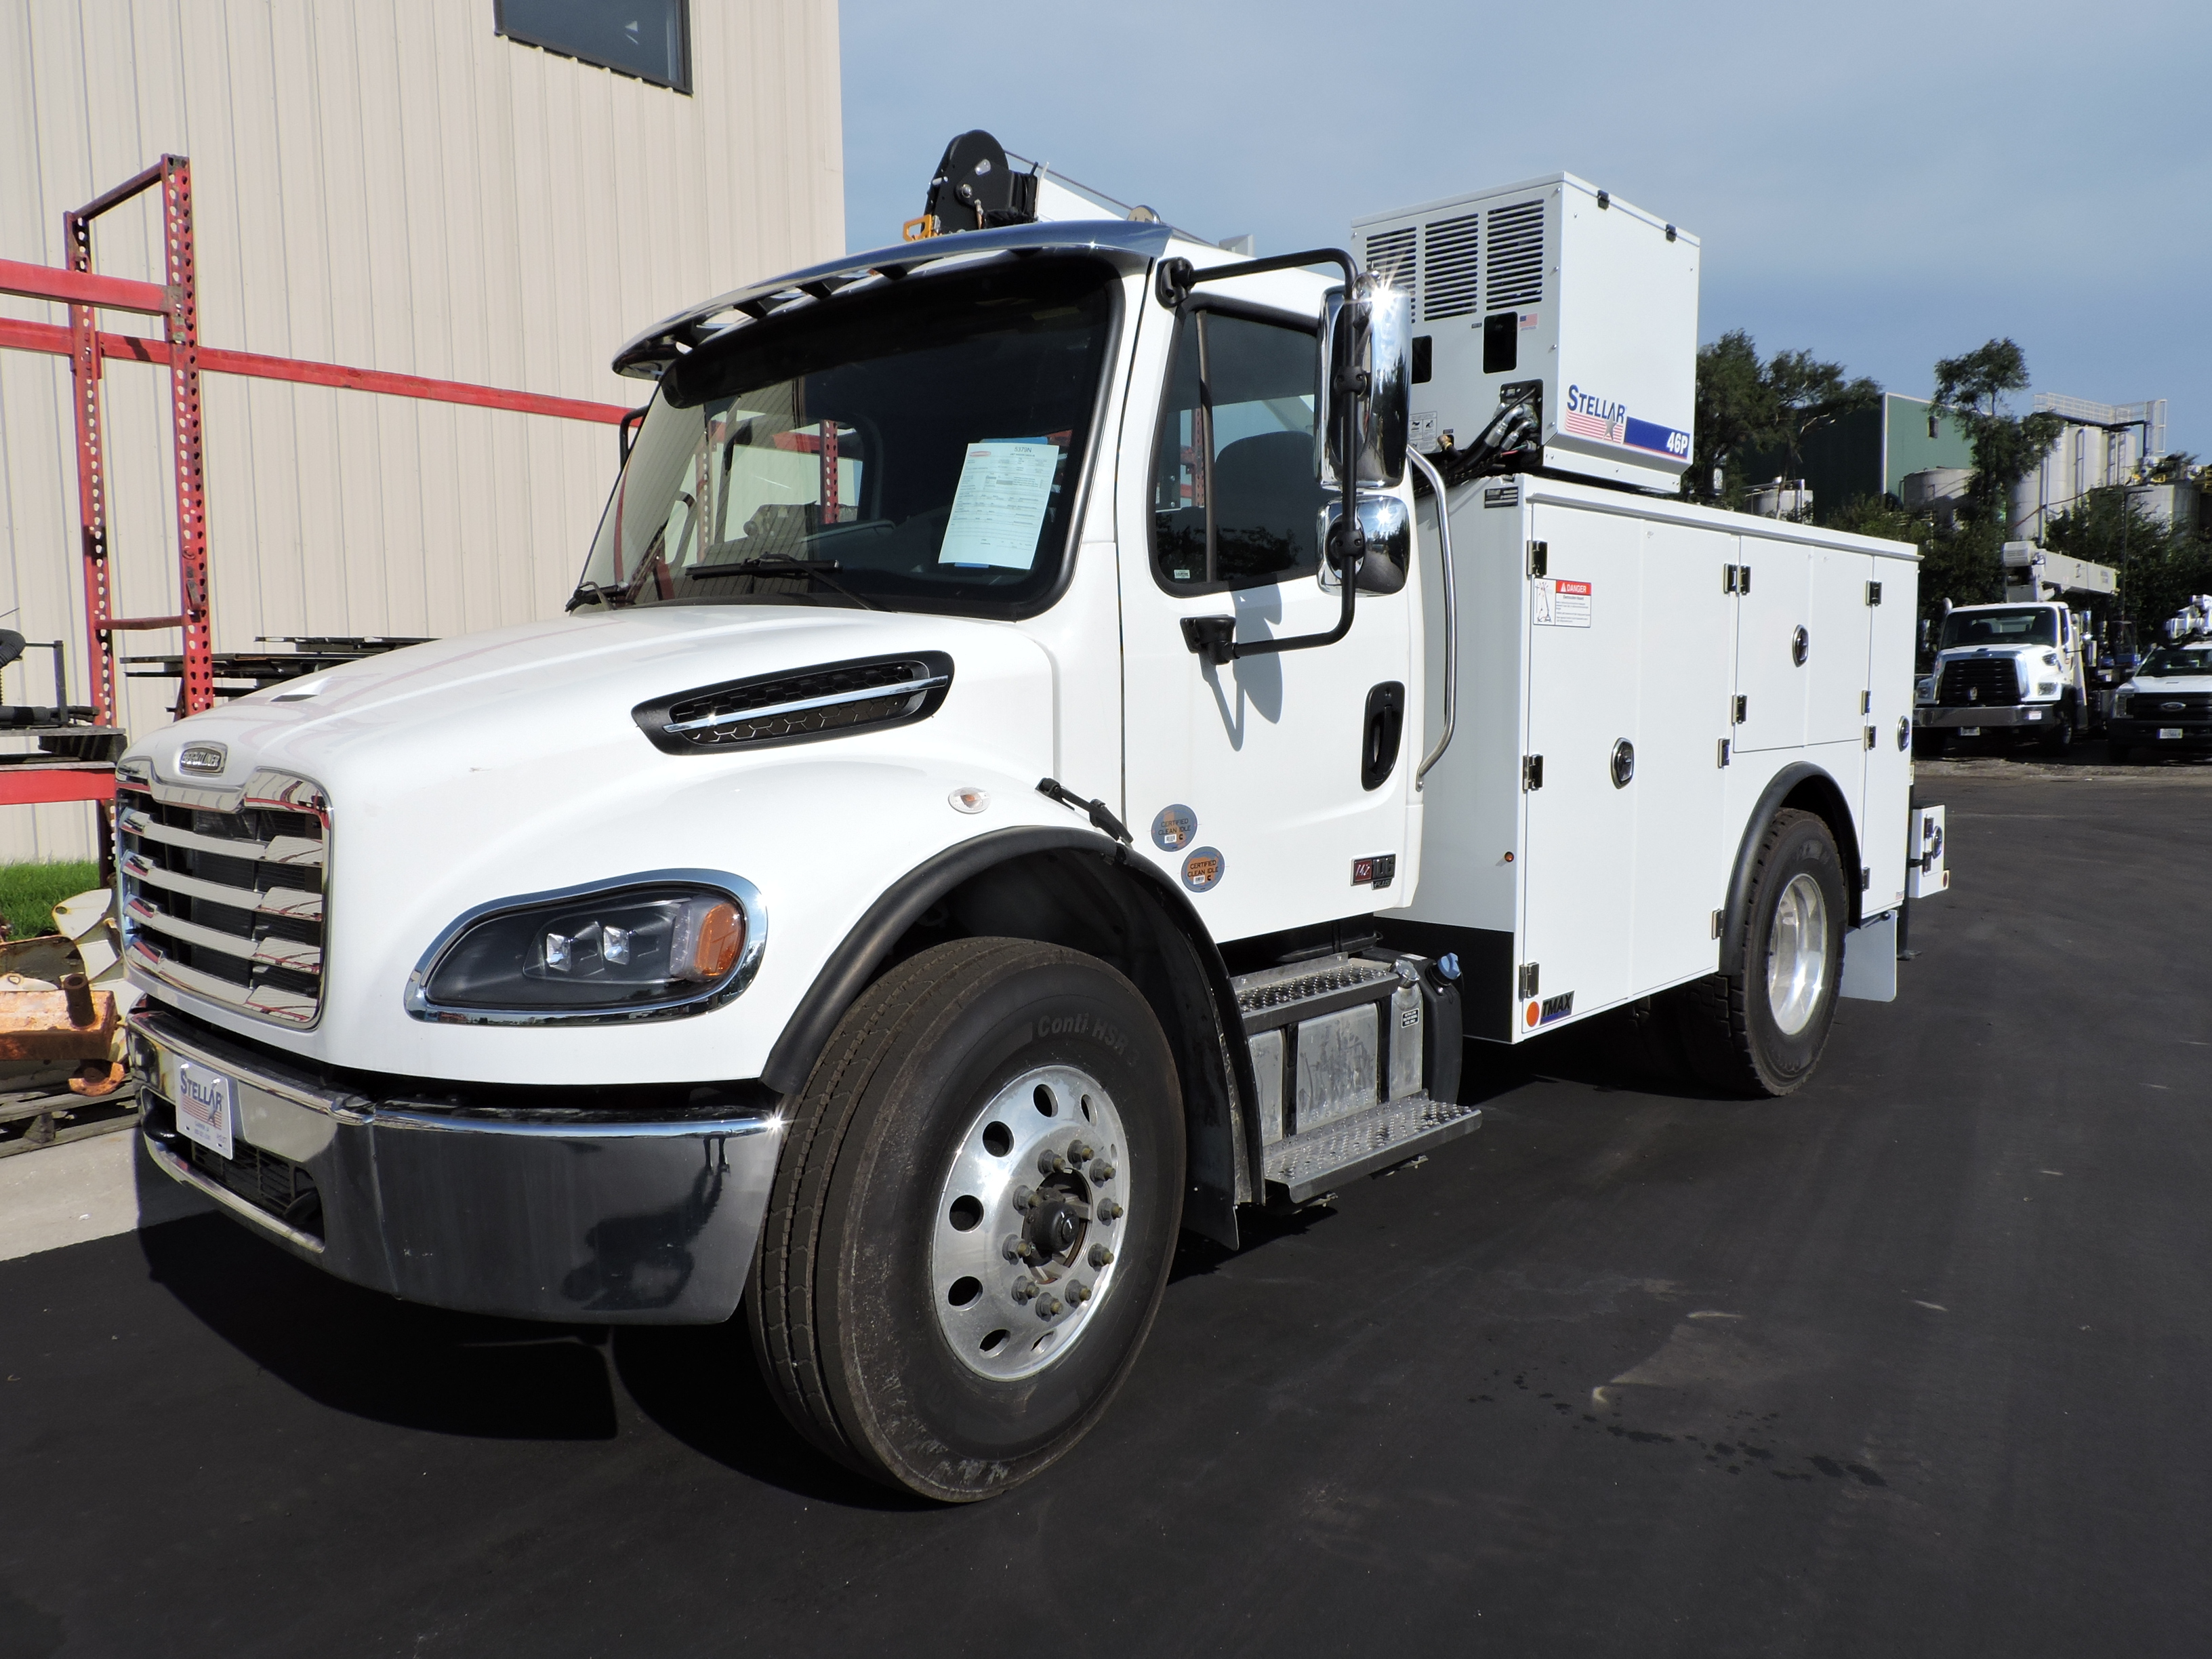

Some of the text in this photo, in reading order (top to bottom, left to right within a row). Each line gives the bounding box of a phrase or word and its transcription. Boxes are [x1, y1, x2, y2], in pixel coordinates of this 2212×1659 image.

[1666, 432, 1689, 455] 46P
[1566, 583, 1586, 593] DANGER
[1160, 818, 1189, 827] CERTIFIED
[1158, 827, 1177, 836] CLEAN
[1190, 859, 1216, 869] CERTIFIED
[1373, 857, 1395, 879] 106
[1187, 866, 1218, 877] CLEAN IDLE
[1542, 993, 1572, 1017] TMAX
[1038, 1012, 1090, 1038] Conti
[1092, 1018, 1128, 1056] HSR
